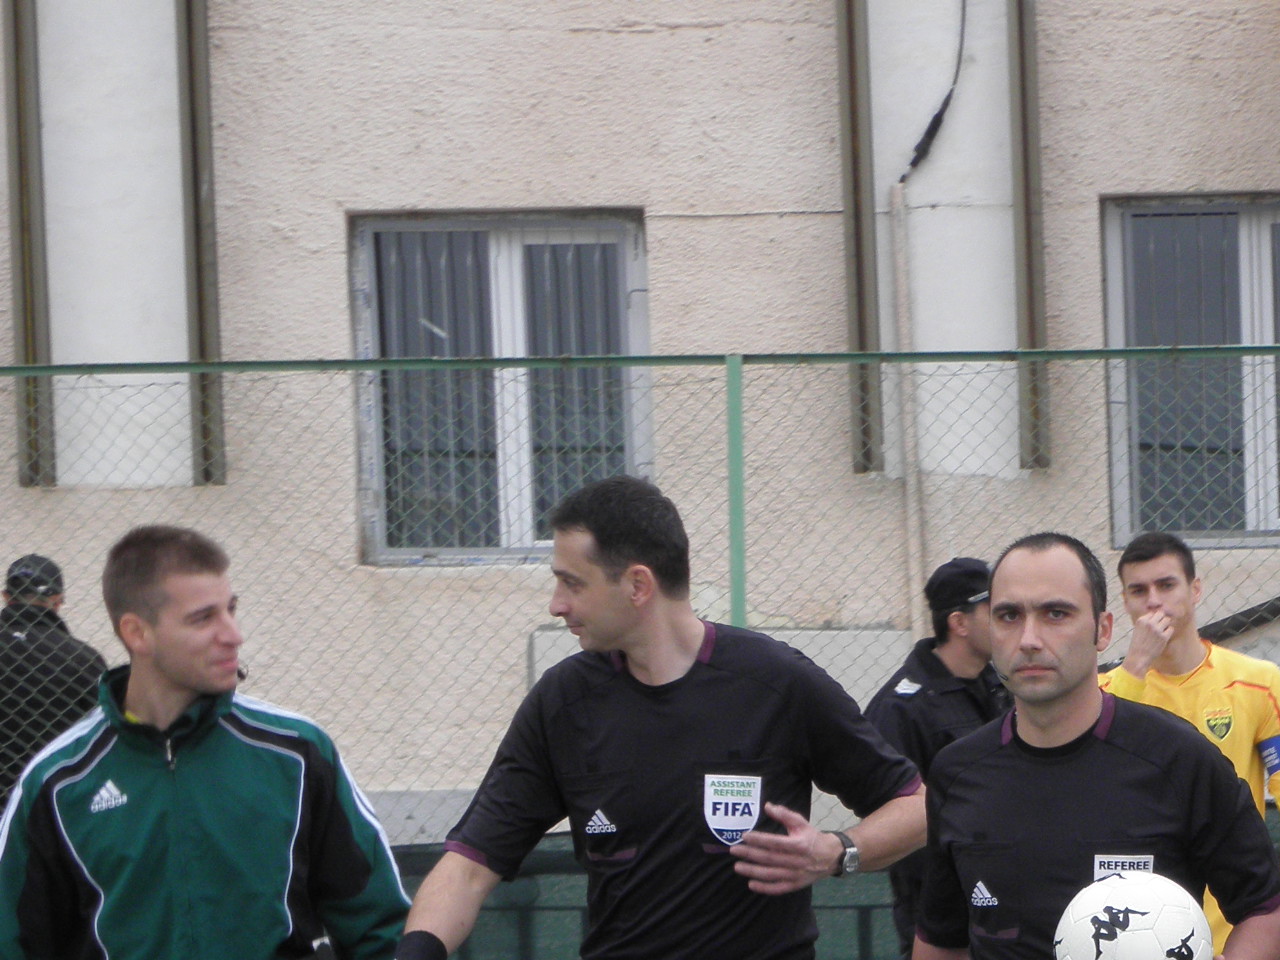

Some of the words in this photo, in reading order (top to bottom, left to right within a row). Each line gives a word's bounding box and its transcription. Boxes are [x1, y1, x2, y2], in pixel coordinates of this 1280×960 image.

[710, 780, 757, 789] ASSISTANT
[713, 788, 753, 798] REFEREE
[711, 801, 753, 817] FIFA
[585, 824, 617, 834] adidas
[722, 831, 742, 839] 2012
[1098, 860, 1151, 871] REFEREE
